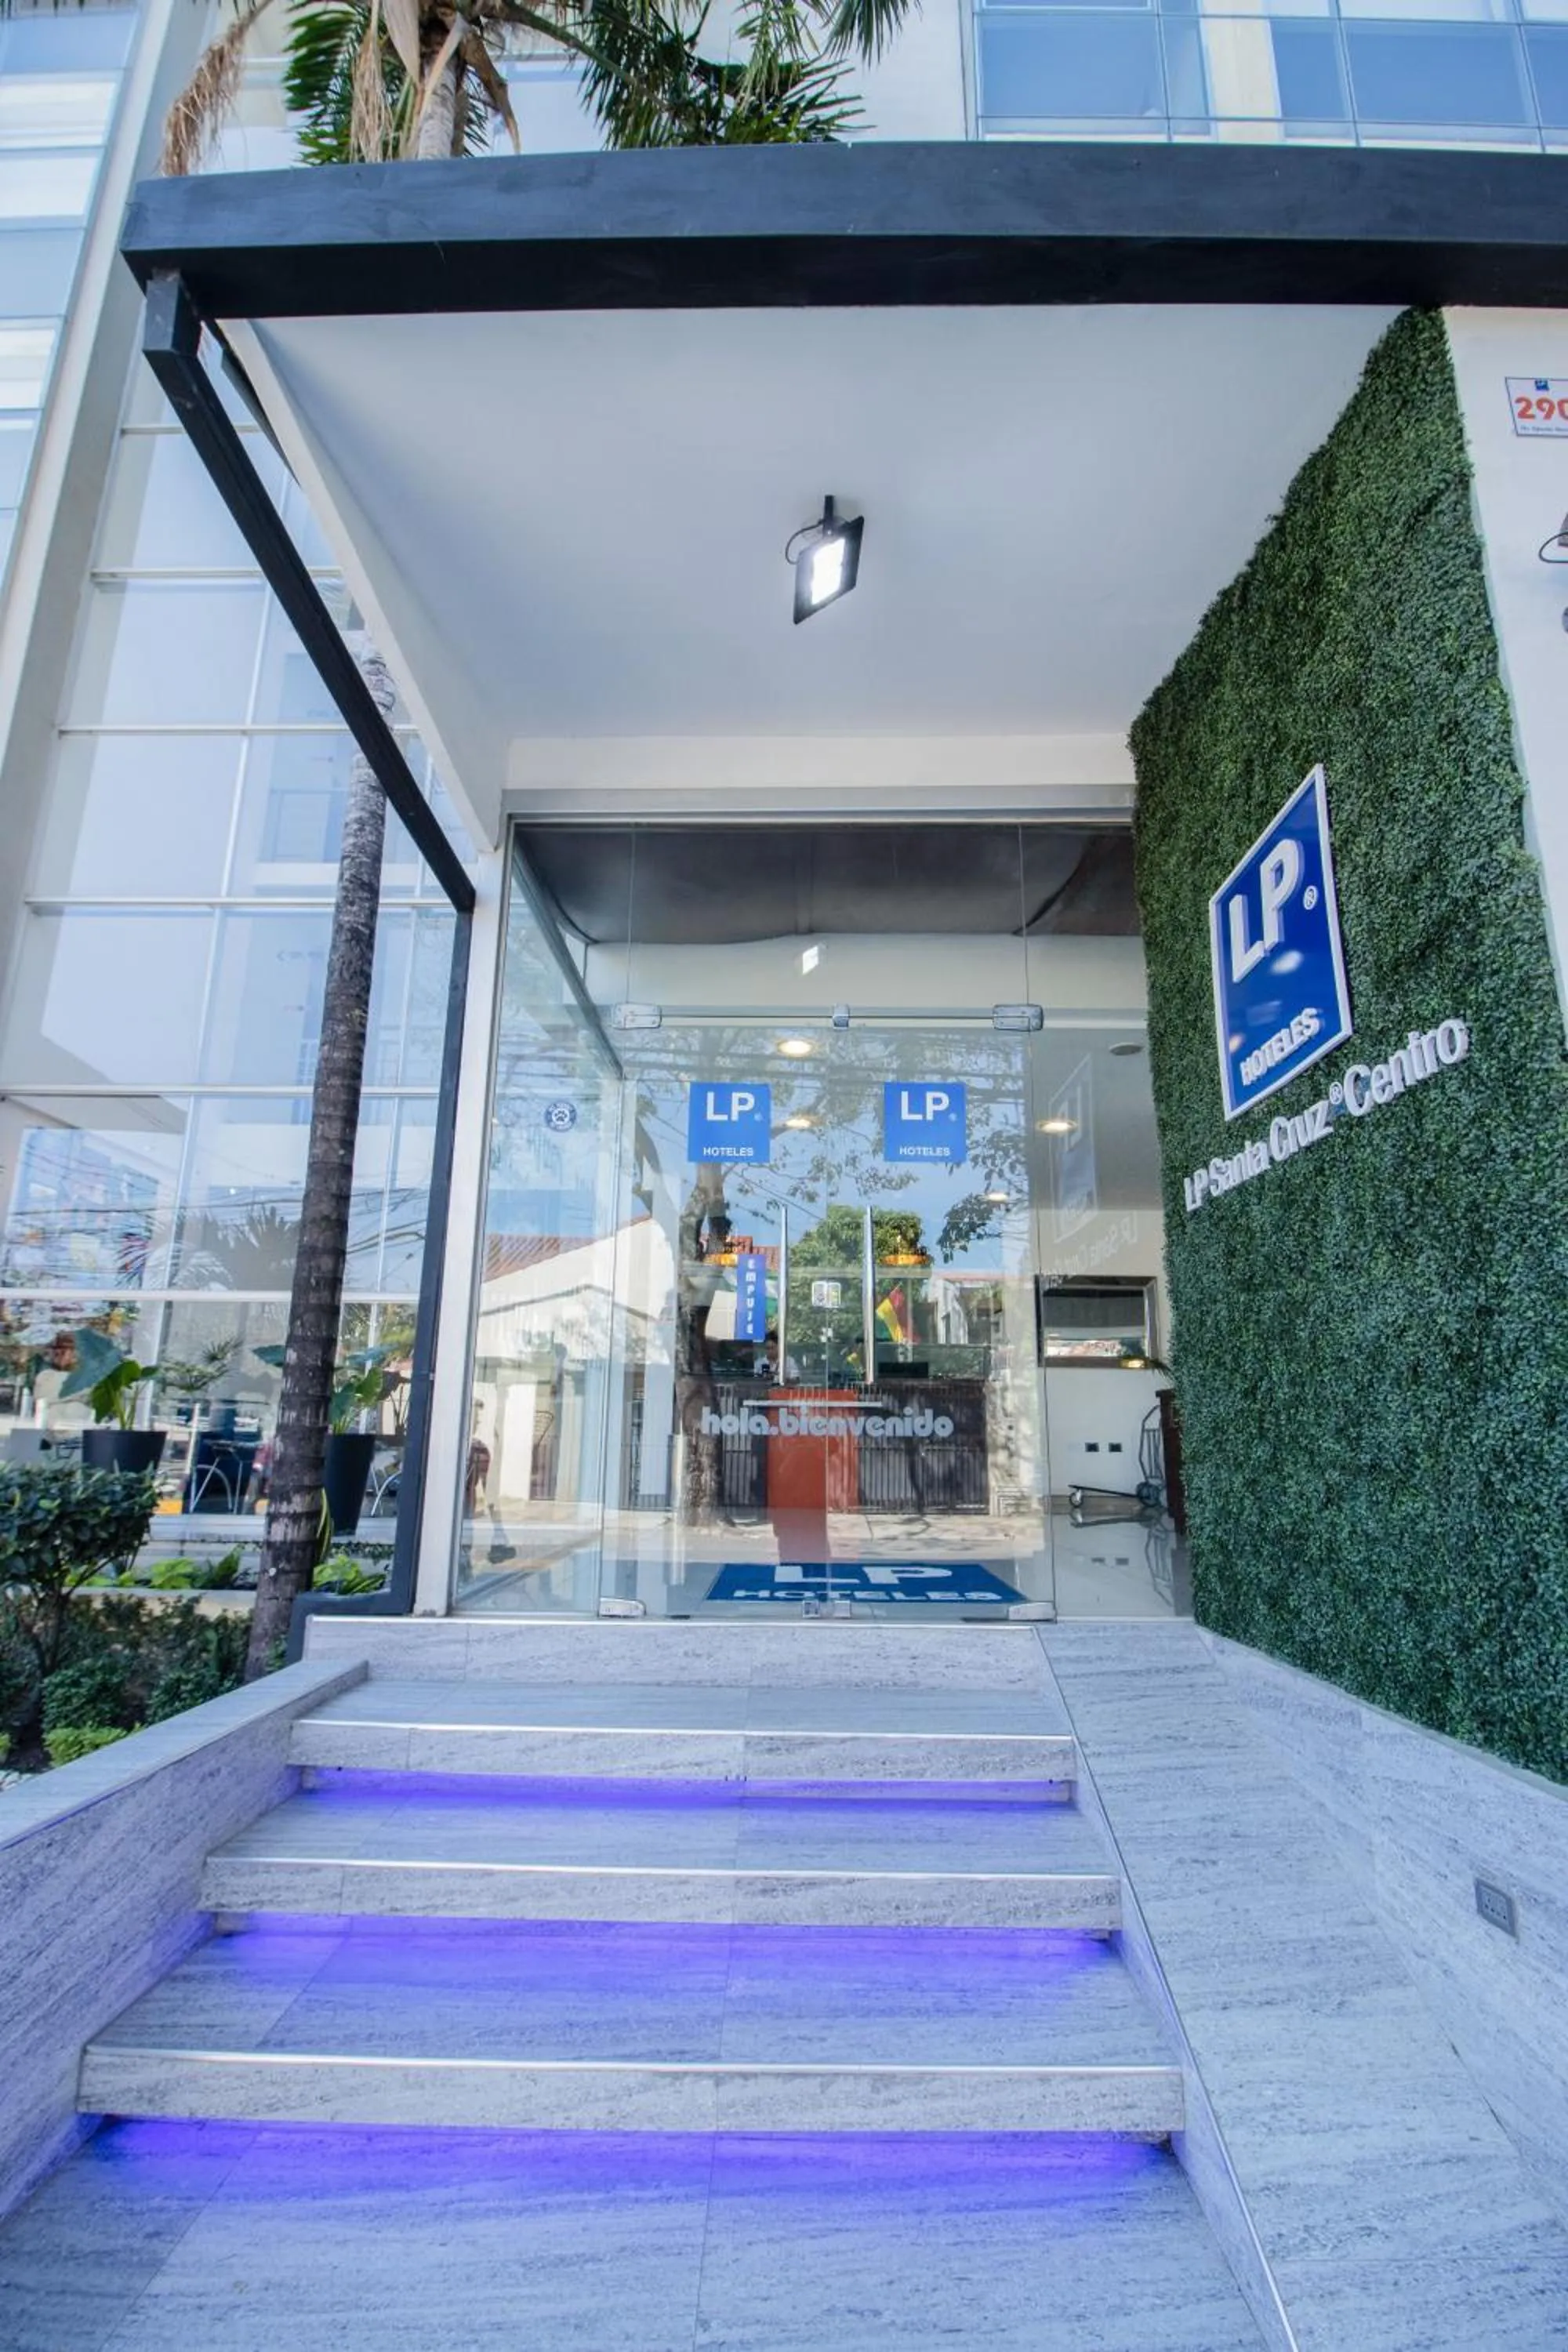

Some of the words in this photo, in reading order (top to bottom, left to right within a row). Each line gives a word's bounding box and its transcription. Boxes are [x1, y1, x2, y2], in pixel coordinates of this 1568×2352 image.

[1240, 1007, 1323, 1086] HOTELES
[1183, 1168, 1209, 1213] LP
[1208, 1140, 1272, 1197] Santa
[1343, 1019, 1469, 1117] Centro
[702, 1147, 754, 1157] HOTELES
[898, 1146, 951, 1157] HOTELES
[746, 1258, 757, 1334] EMPUJE
[774, 1566, 953, 1584] LP
[732, 1589, 1003, 1601] HOTELES
